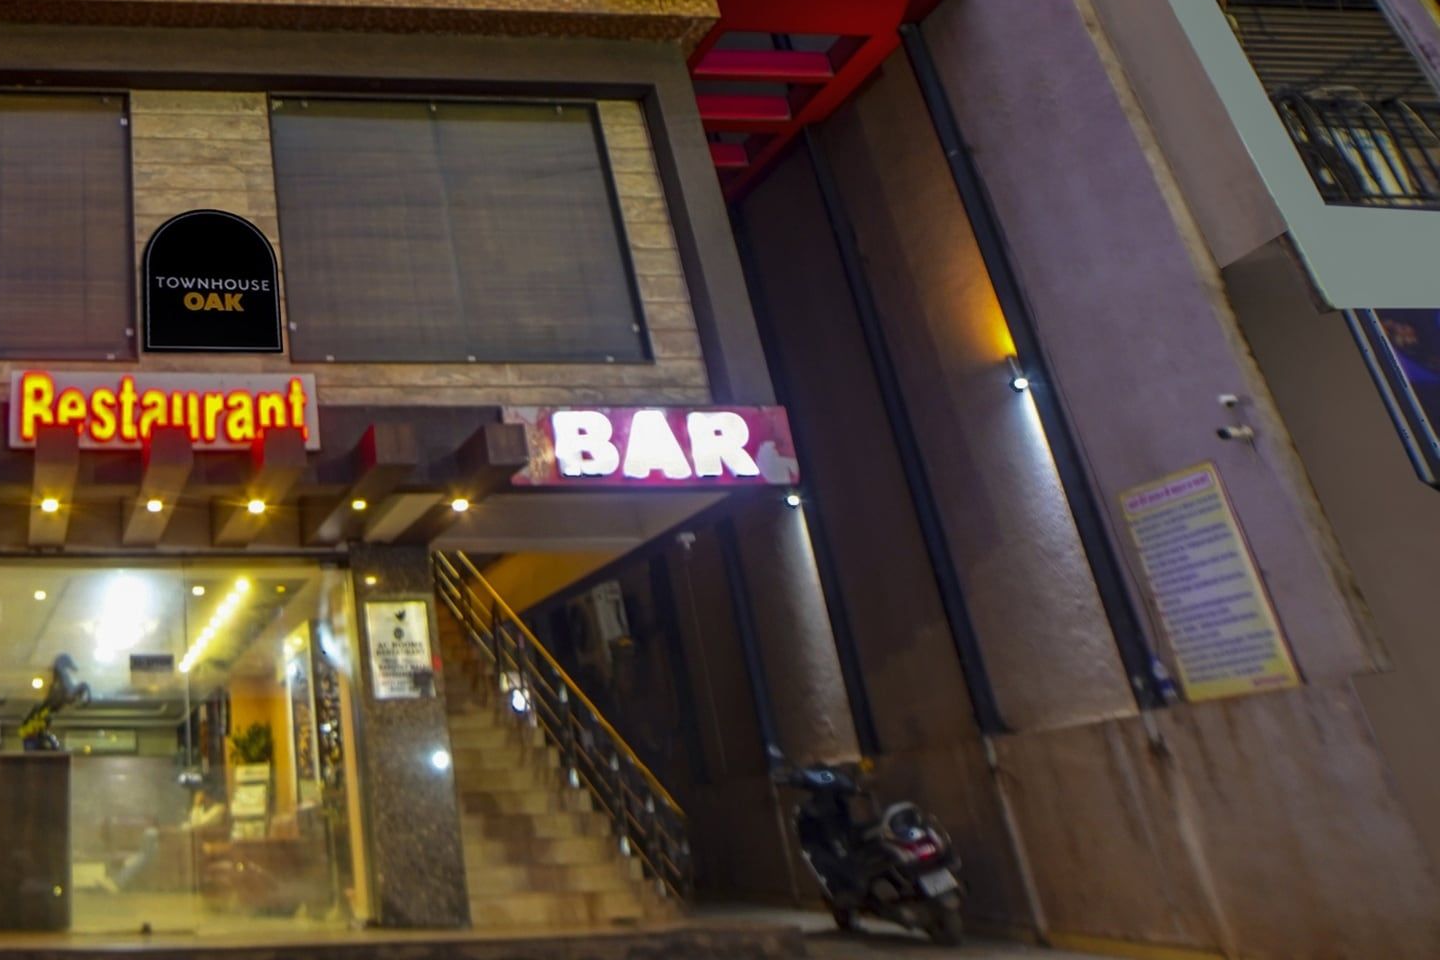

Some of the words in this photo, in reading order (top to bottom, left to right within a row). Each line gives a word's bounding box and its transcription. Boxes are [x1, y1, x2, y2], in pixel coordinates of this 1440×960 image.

[155, 276, 270, 291] TOWNHOUSE
[183, 292, 244, 312] OAK
[20, 370, 308, 441] Restaurant
[552, 410, 760, 479] BAR
